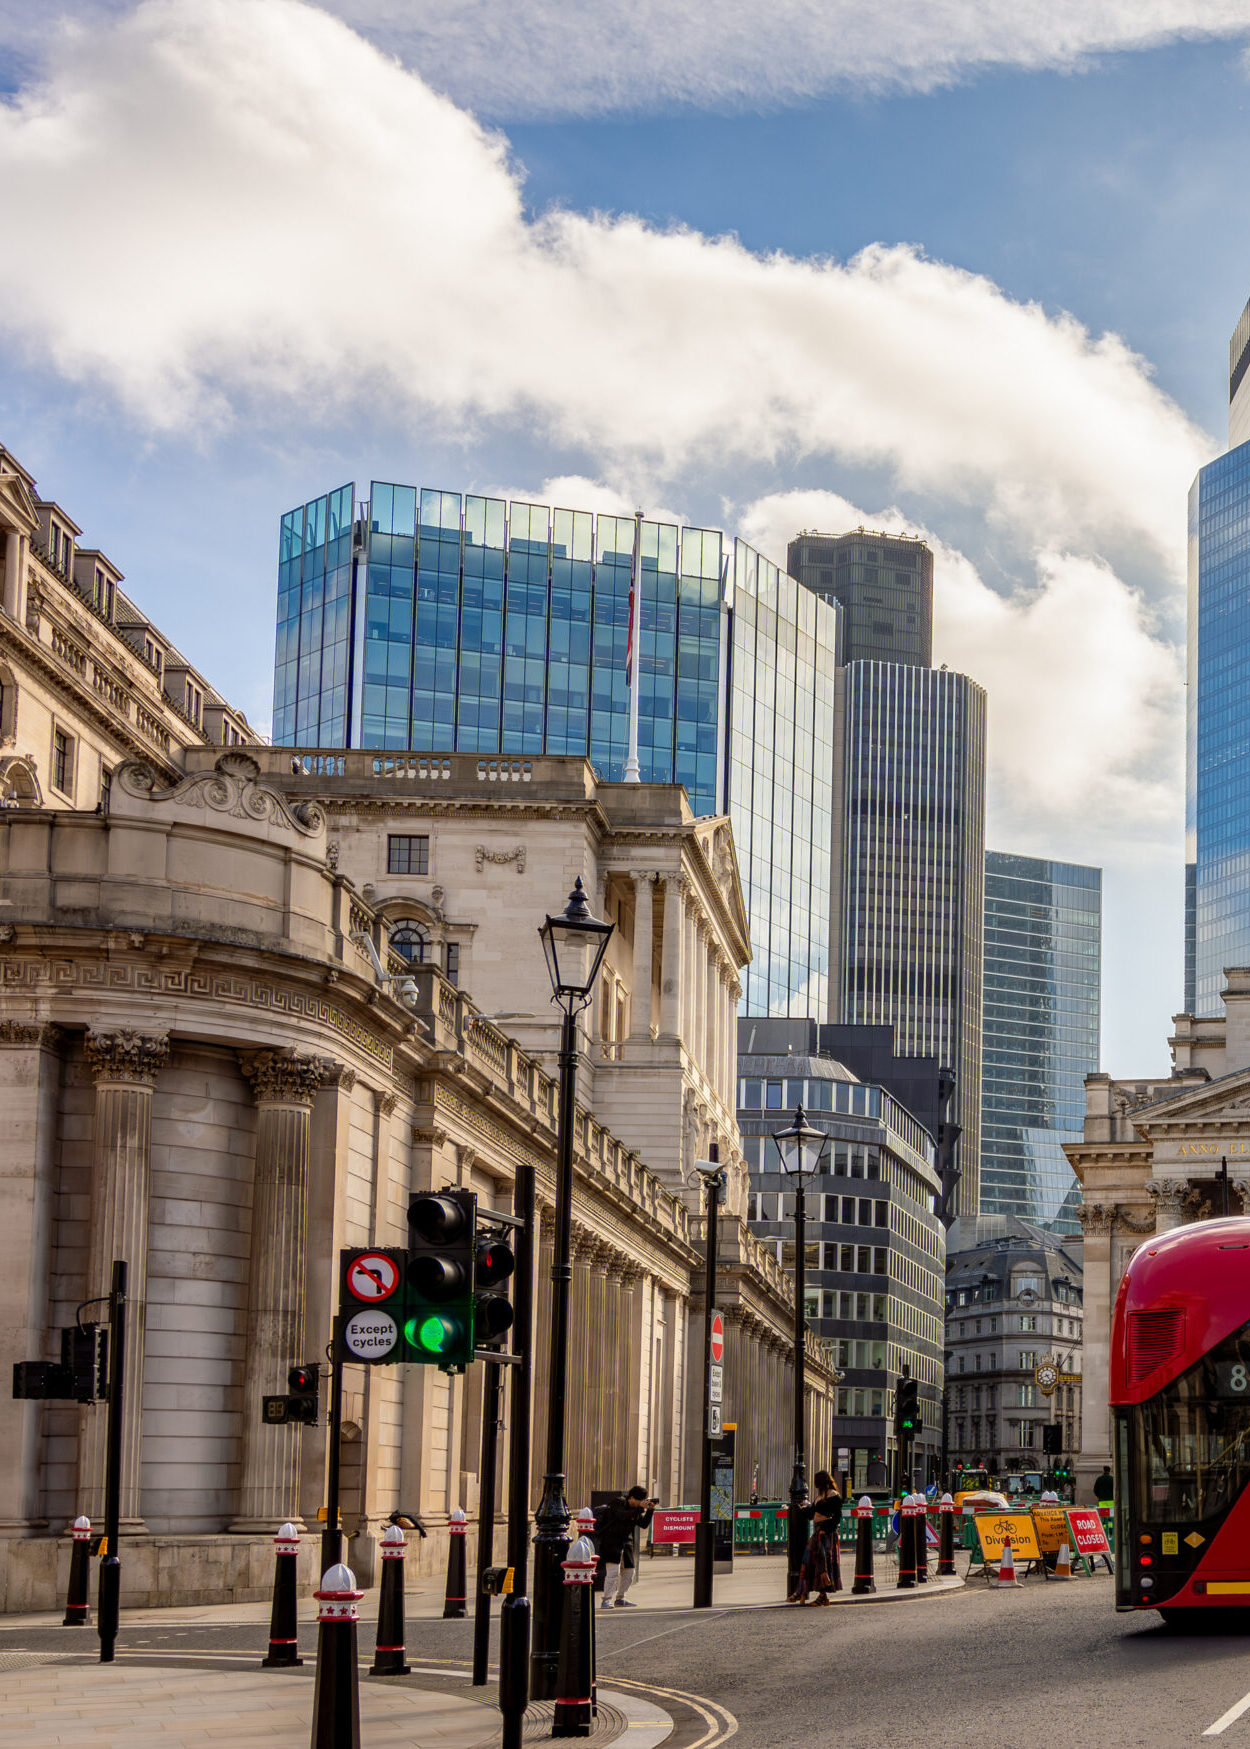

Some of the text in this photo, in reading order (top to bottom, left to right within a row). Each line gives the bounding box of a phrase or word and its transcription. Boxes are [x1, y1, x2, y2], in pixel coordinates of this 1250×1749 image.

[1176, 1143, 1219, 1156] ANNO
[351, 1323, 393, 1334] Except
[353, 1337, 392, 1348] cycles
[1230, 1364, 1247, 1392] 8
[1076, 1519, 1096, 1530] ROAD
[984, 1535, 1031, 1545] Divesion
[1077, 1534, 1105, 1545] CLOSED
